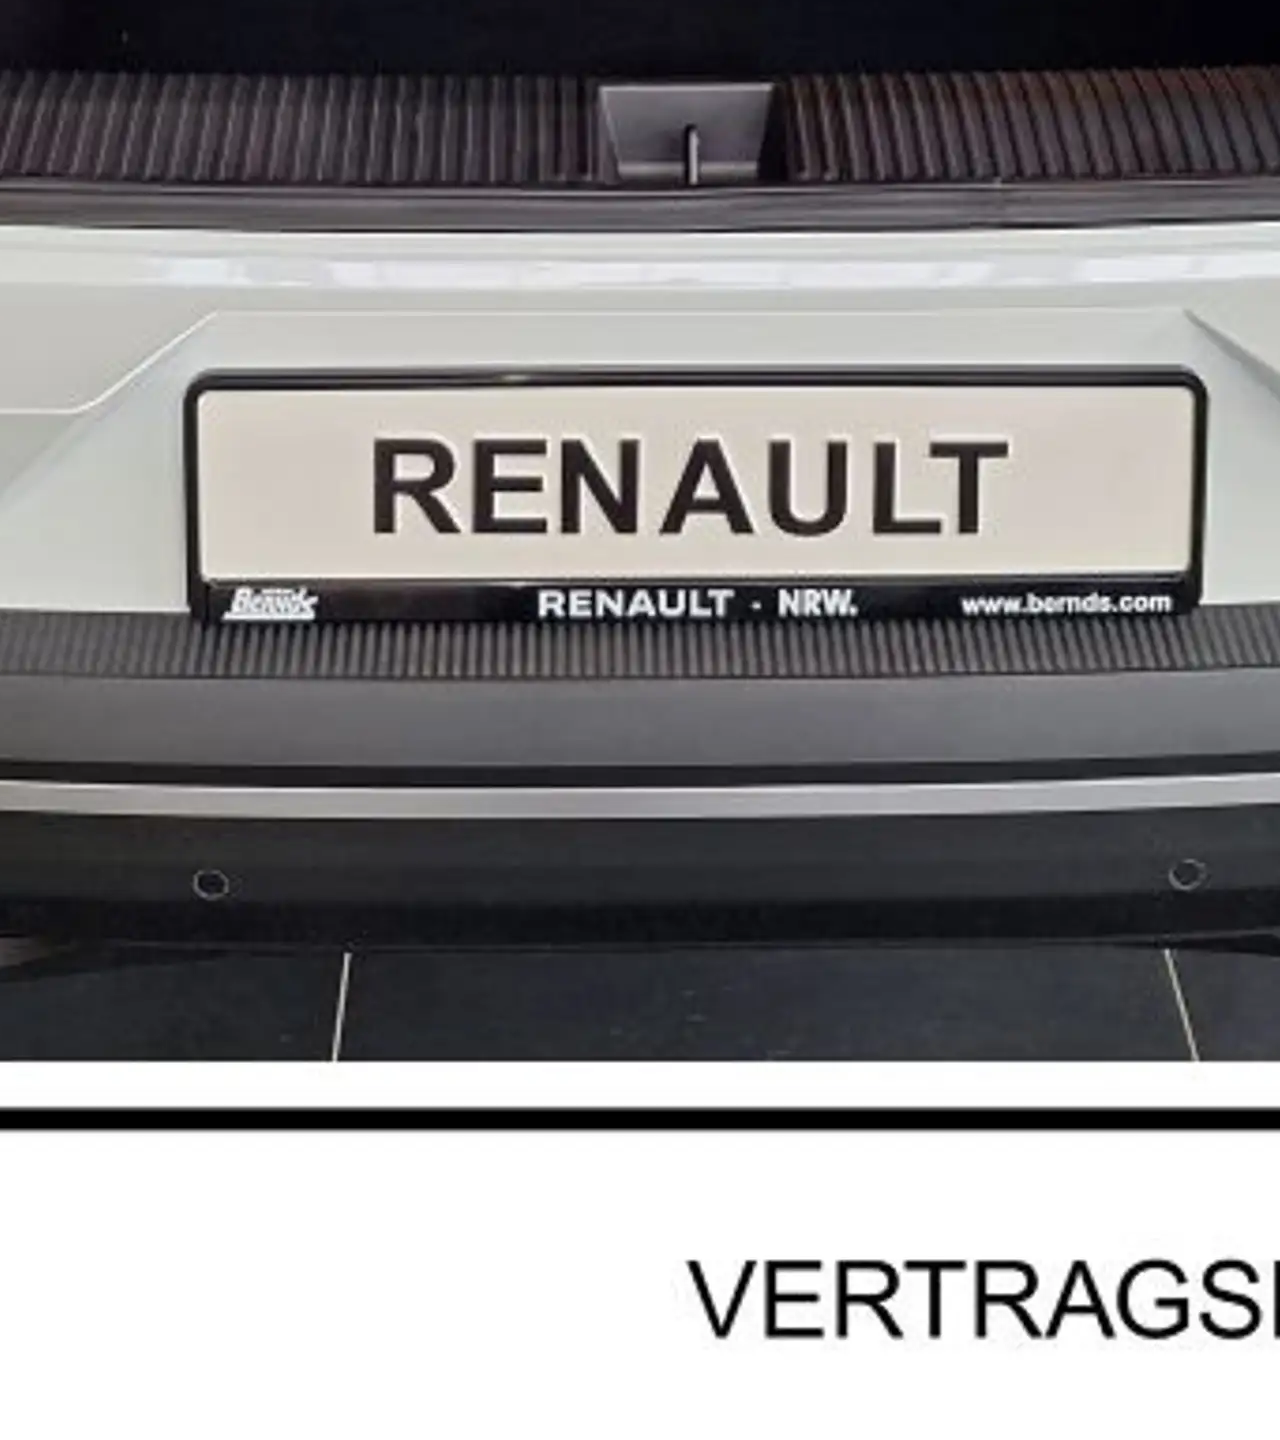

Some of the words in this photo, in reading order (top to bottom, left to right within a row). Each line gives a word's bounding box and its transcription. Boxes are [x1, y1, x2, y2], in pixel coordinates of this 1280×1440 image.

[374, 439, 1009, 537] RENAULT
[537, 589, 735, 618] RENAULT
[777, 588, 859, 617] NRW.
[961, 592, 1173, 616] www.bernds.com
